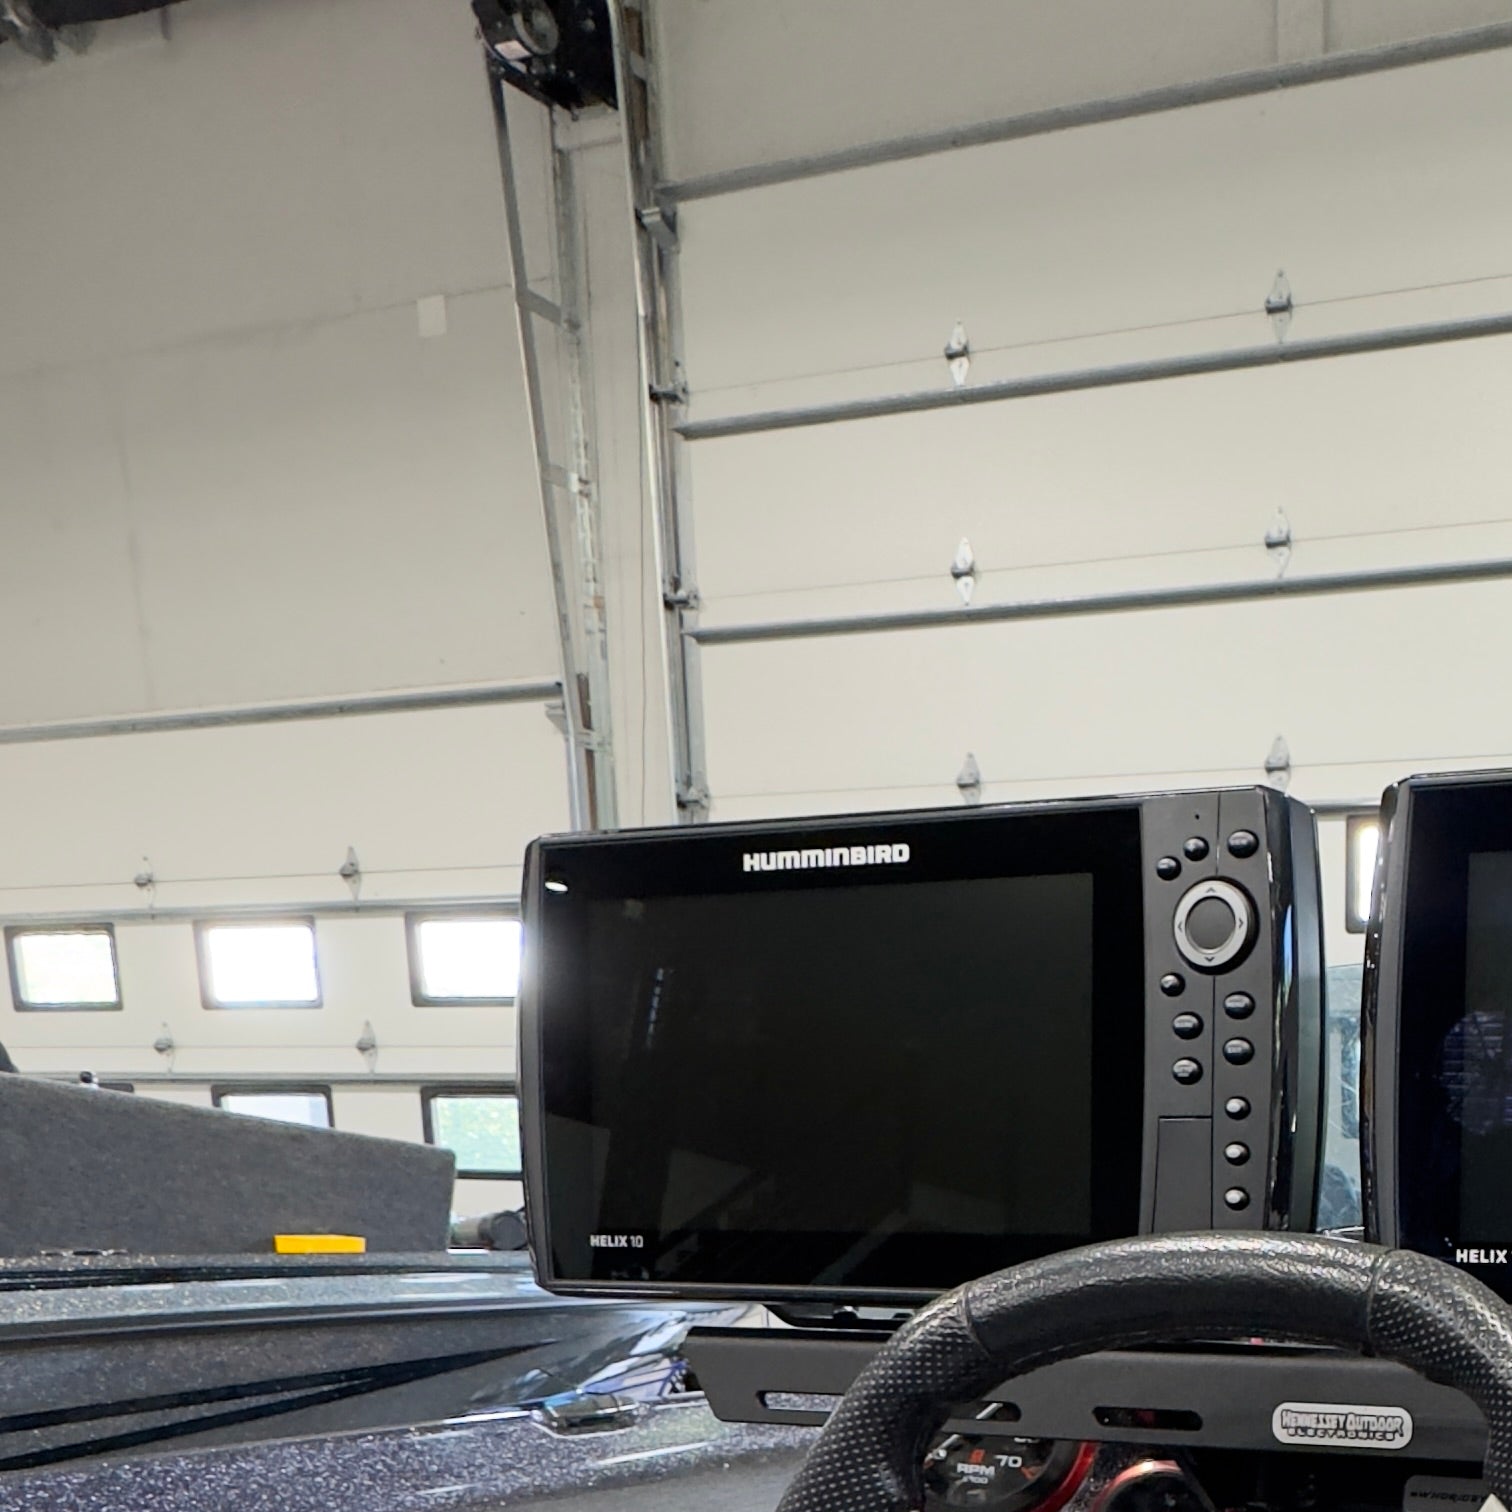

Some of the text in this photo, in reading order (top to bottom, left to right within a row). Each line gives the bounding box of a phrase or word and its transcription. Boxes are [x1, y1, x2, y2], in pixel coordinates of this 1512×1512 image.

[743, 843, 910, 871] HUMMINBIRD
[590, 1234, 644, 1248] HELIX 10
[1456, 1248, 1508, 1264] HELIX
[994, 1454, 1023, 1468] 70
[957, 1463, 995, 1478] RPM
